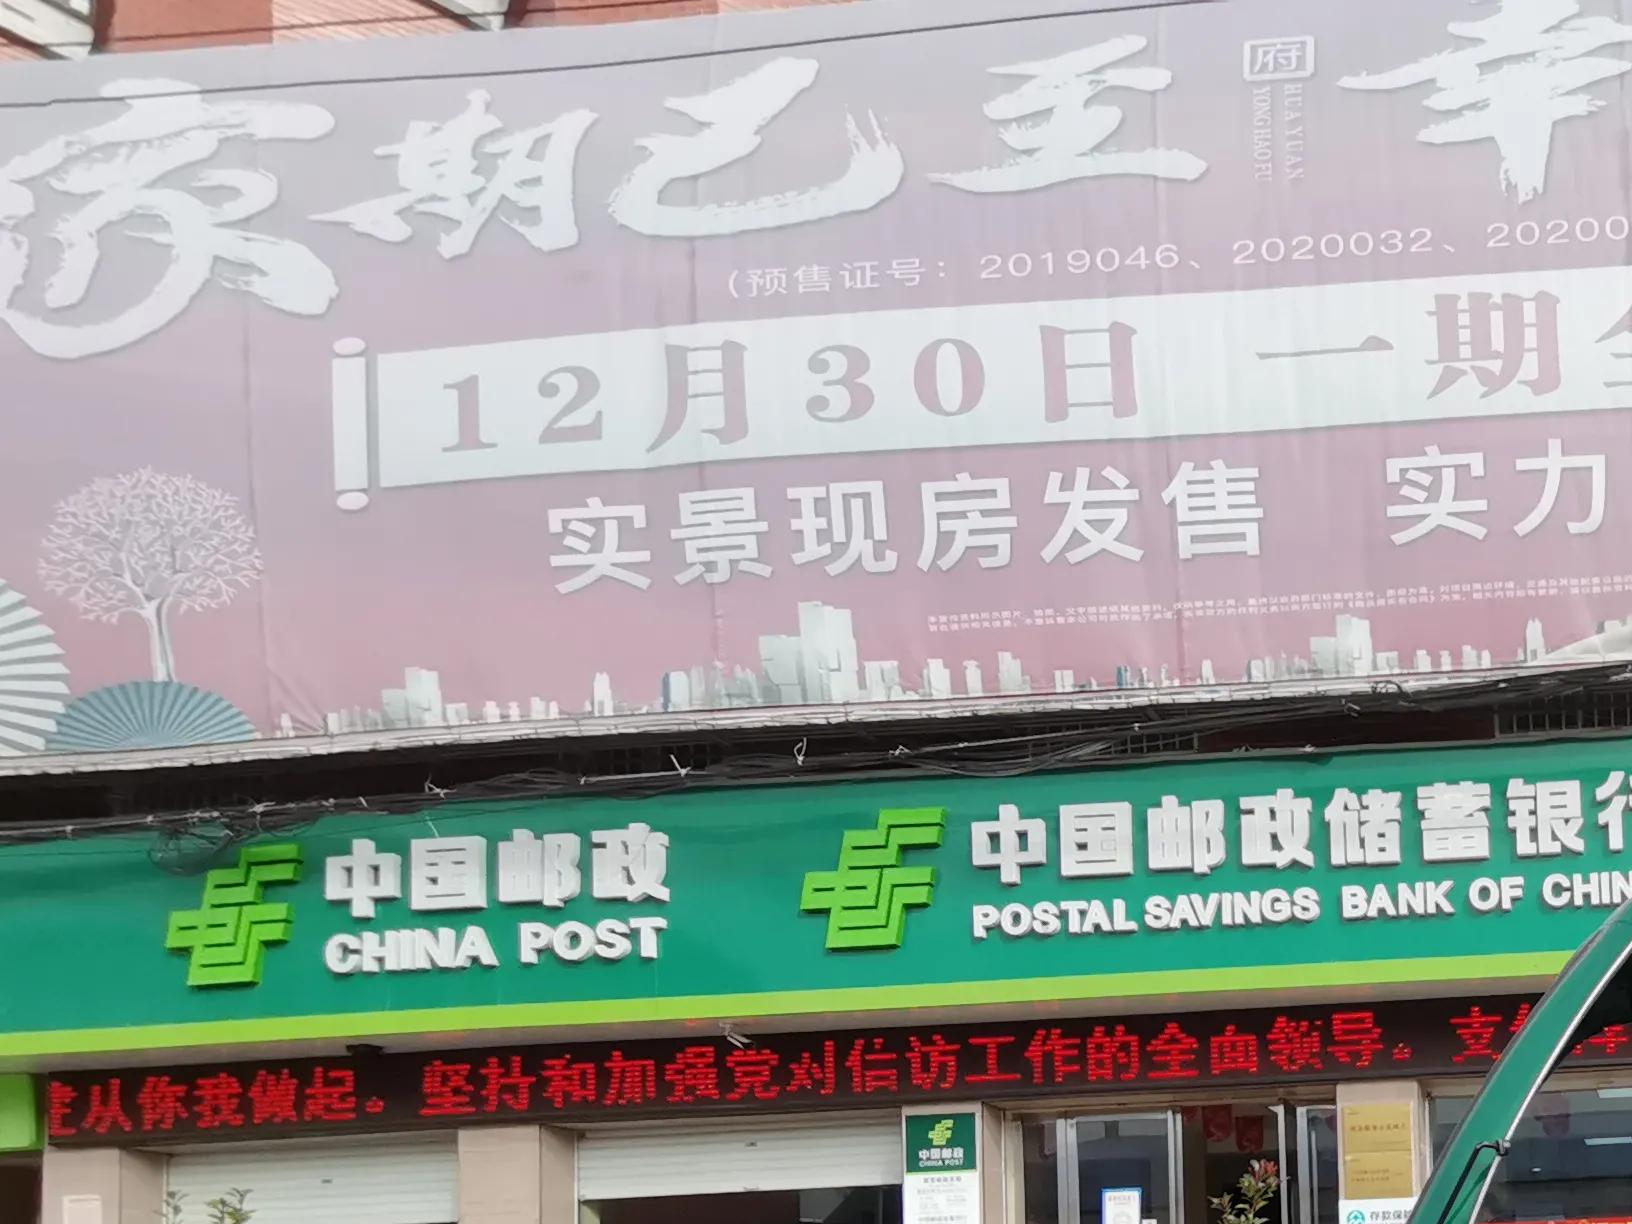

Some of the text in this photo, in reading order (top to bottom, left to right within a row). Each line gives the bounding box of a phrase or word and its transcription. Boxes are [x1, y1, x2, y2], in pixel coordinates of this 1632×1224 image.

[1253, 43, 1302, 73] 府
[441, 320, 1140, 453] 12月30日
[548, 459, 1265, 594] 实景现房发售
[323, 822, 671, 919] 中国邮政
[972, 896, 1136, 940] POSTAL
[1144, 885, 1320, 928] SAVINGS
[1341, 880, 1454, 920] BANK
[1469, 877, 1524, 912] OF
[323, 915, 668, 976] CHINA POST
